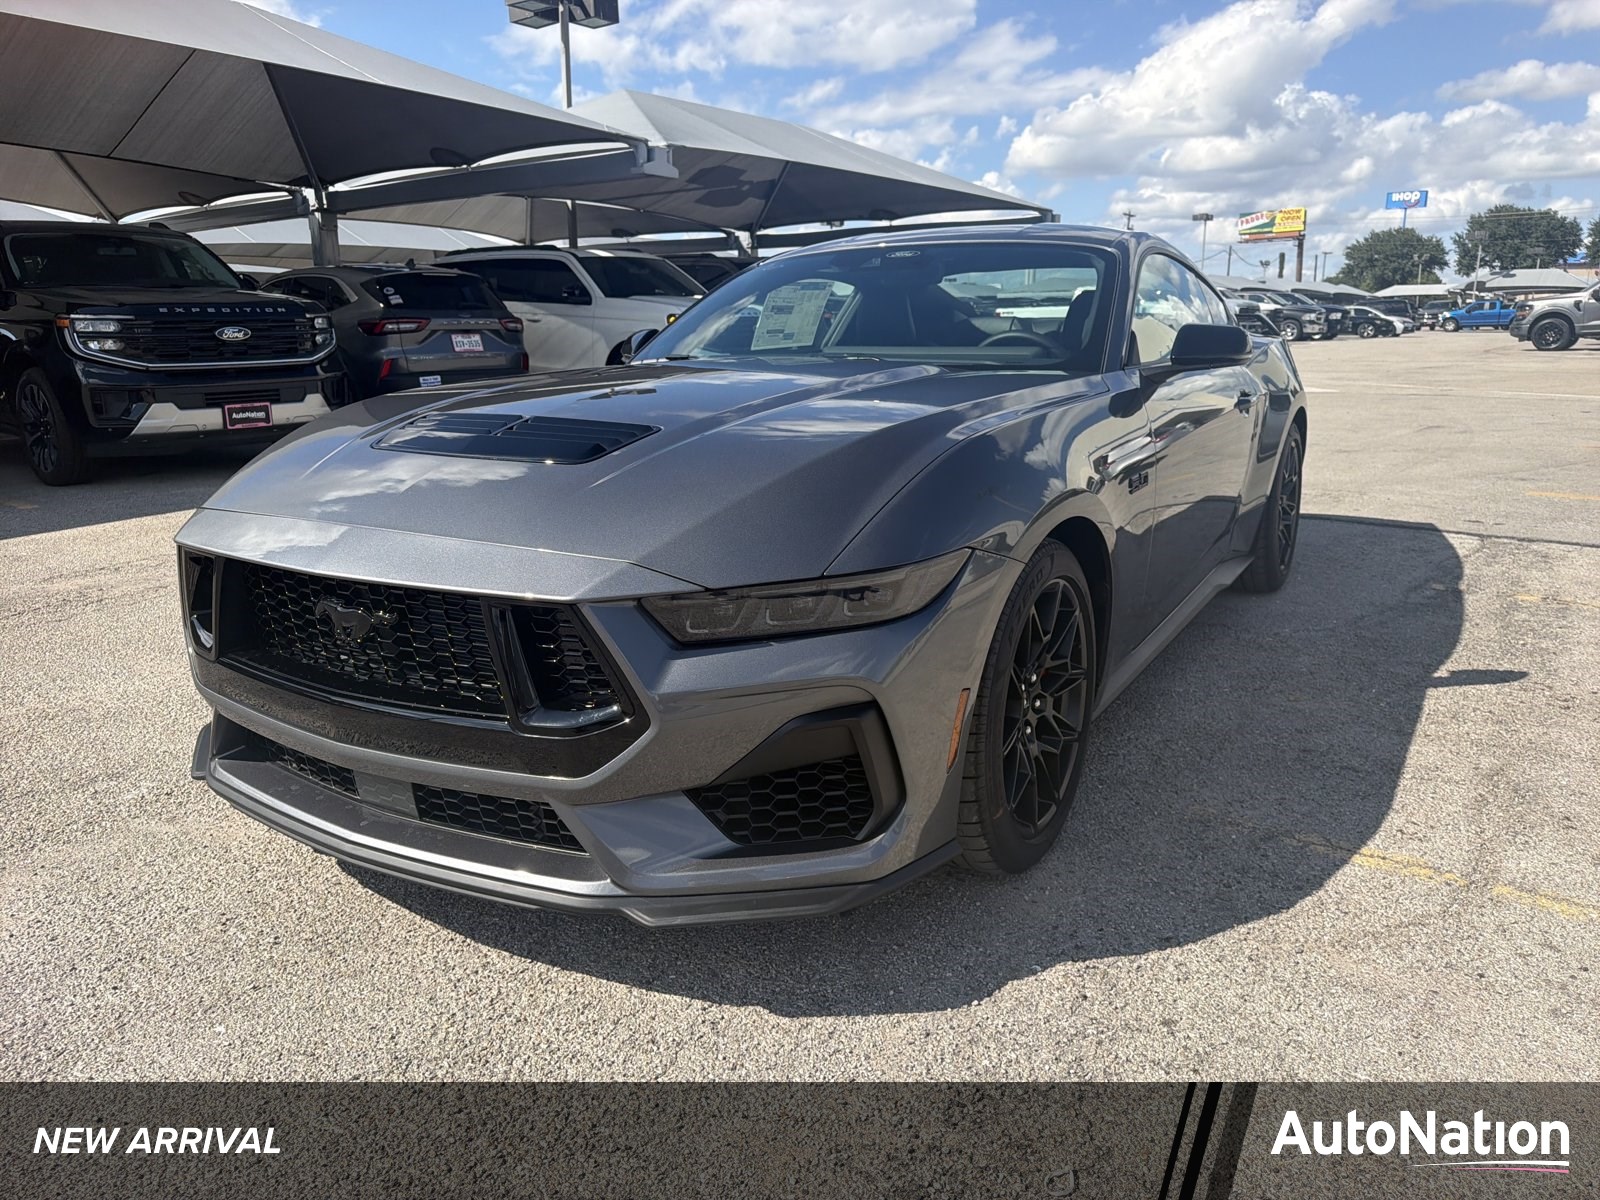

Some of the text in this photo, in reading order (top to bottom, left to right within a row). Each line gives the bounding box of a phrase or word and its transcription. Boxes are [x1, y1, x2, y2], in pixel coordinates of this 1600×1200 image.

[1392, 191, 1421, 203] IHOP
[1280, 214, 1302, 222] OPEN
[232, 411, 266, 419] AutoNation
